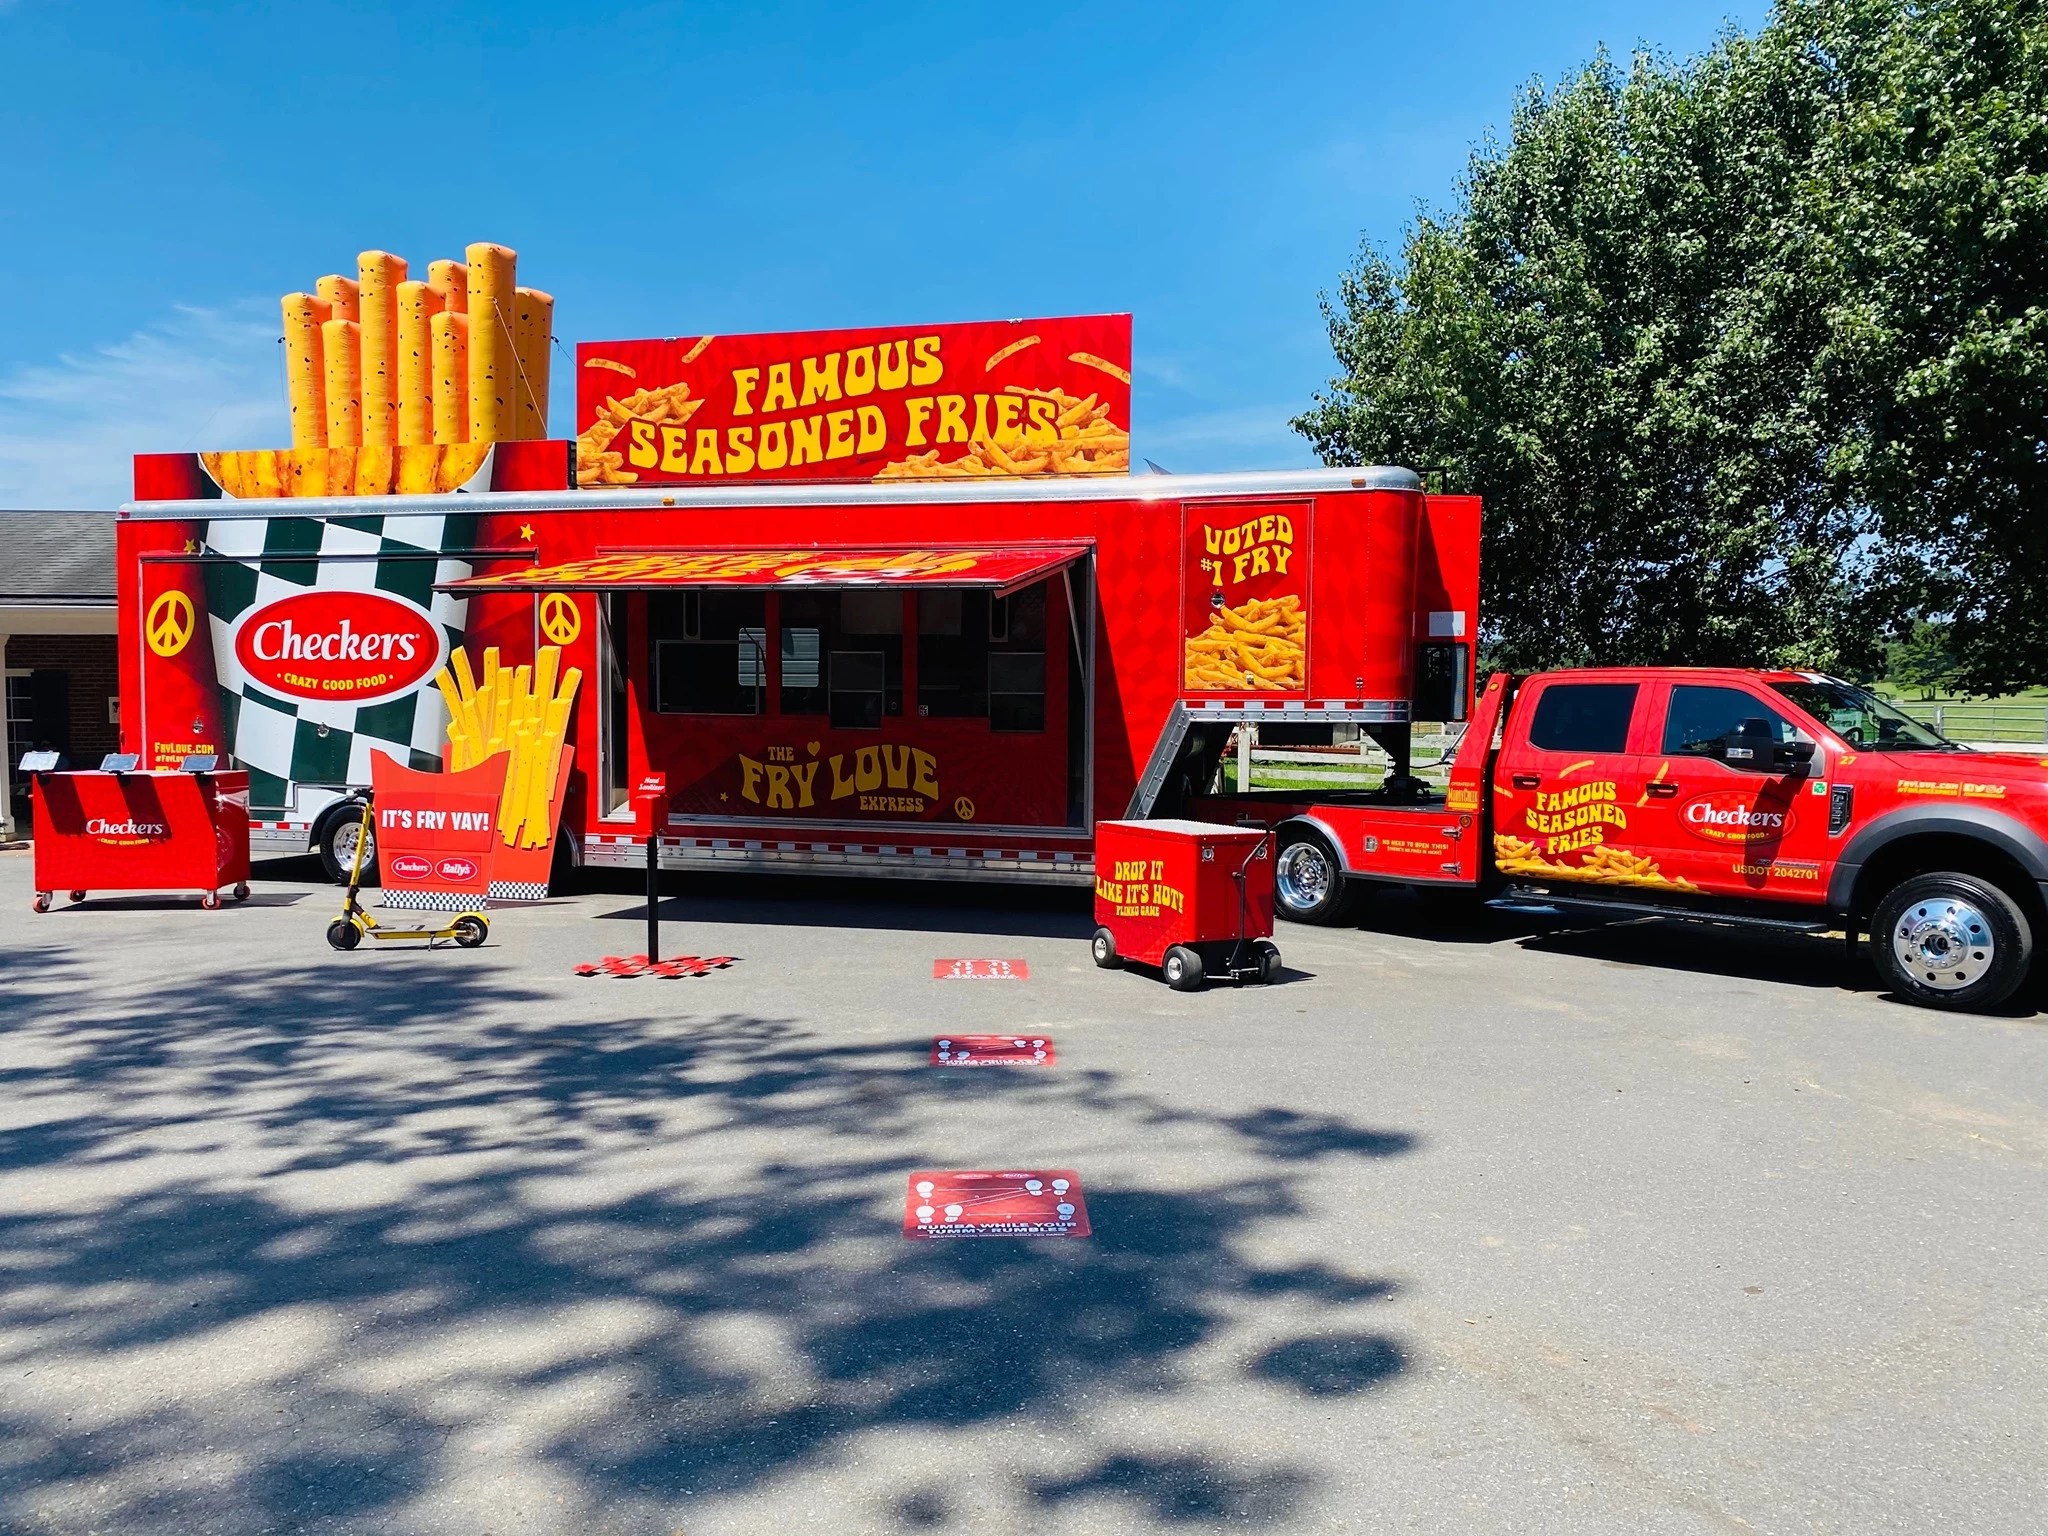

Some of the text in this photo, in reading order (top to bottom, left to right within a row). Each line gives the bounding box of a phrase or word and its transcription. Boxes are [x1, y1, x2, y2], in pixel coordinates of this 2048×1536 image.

[732, 336, 943, 416] FAMOUS
[628, 394, 1058, 474] SEASONED FRIES
[1204, 515, 1293, 555] VOTED
[1201, 545, 1292, 586] #1 FRY
[253, 619, 418, 660] Checkers
[284, 673, 386, 690] CRAZY GOOD FOOD
[768, 746, 794, 761] THE
[1840, 756, 1856, 765] 27
[739, 744, 939, 809] FRY LOVE
[860, 796, 924, 812] EXPRESS
[1536, 782, 1616, 811] FAMOUS
[382, 810, 412, 828] IT'S
[417, 810, 446, 830] FRY
[1526, 804, 1626, 833] SEASONED
[1688, 803, 1783, 827] Checkers
[86, 819, 163, 834] Checkers
[1705, 828, 1725, 838] CRAZY
[1548, 826, 1603, 854] FRIES
[395, 862, 472, 876] Checkers Rally's
[1115, 860, 1163, 881] DROP IT
[1732, 864, 1771, 876] USDOT
[1774, 867, 1819, 880] 2042701
[1096, 875, 1184, 914] LIKE IT'S HOT!
[1116, 906, 1159, 917] PLINKO GAME
